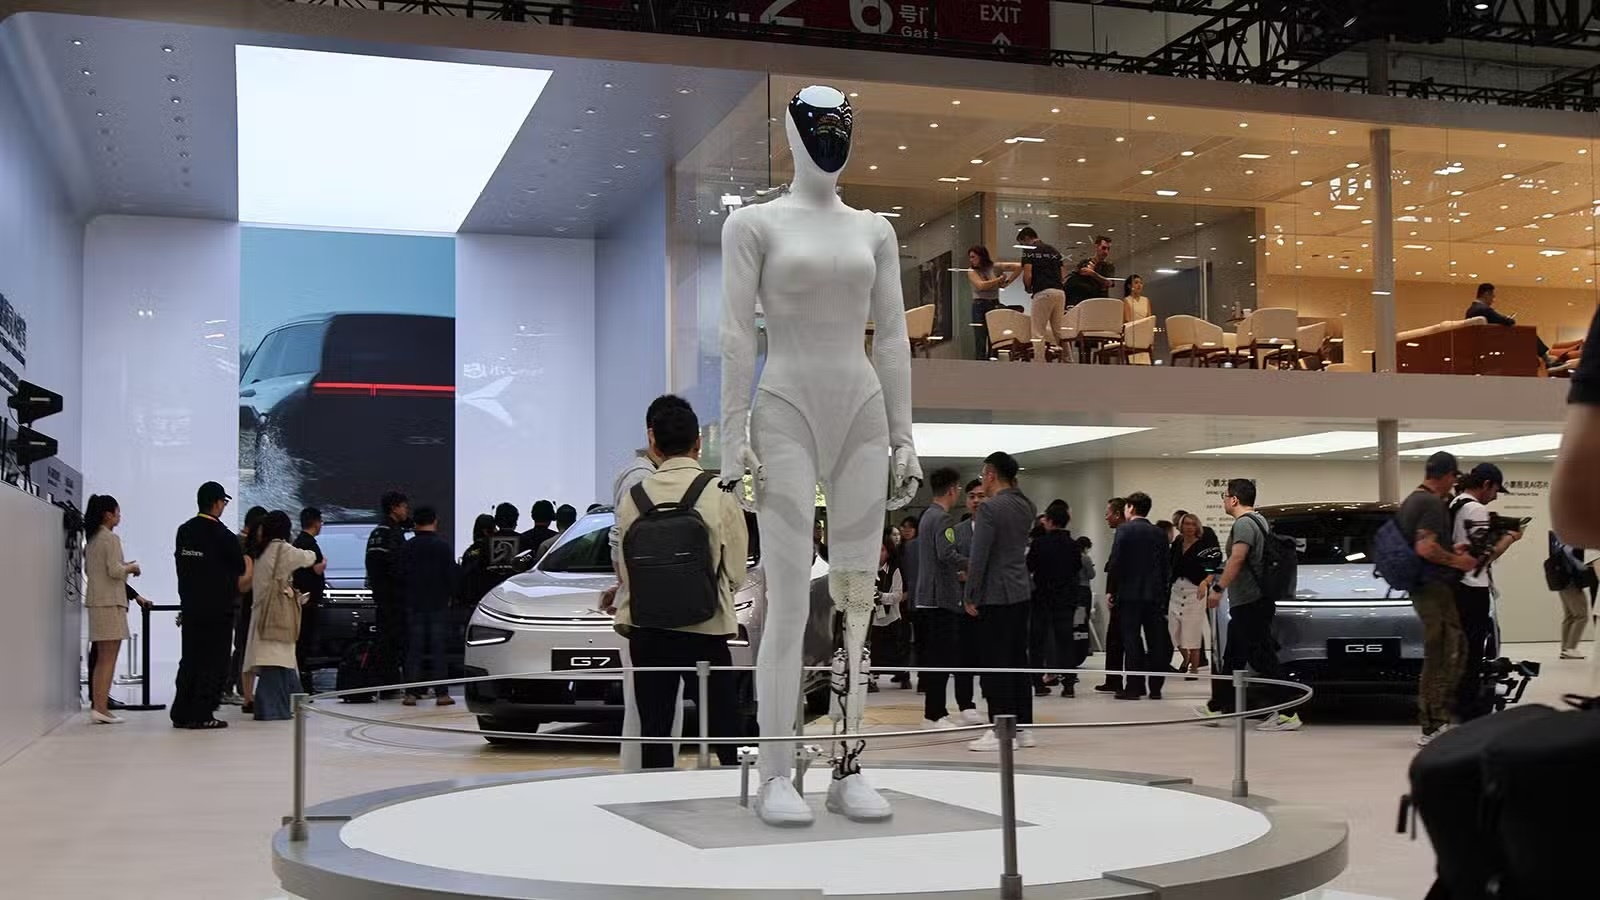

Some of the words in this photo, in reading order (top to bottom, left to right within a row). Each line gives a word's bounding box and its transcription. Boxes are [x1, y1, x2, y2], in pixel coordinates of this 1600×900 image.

[849, 0, 893, 34] 6
[980, 4, 1021, 24] EXIT
[1345, 644, 1383, 653] G6
[570, 656, 611, 666] G7
